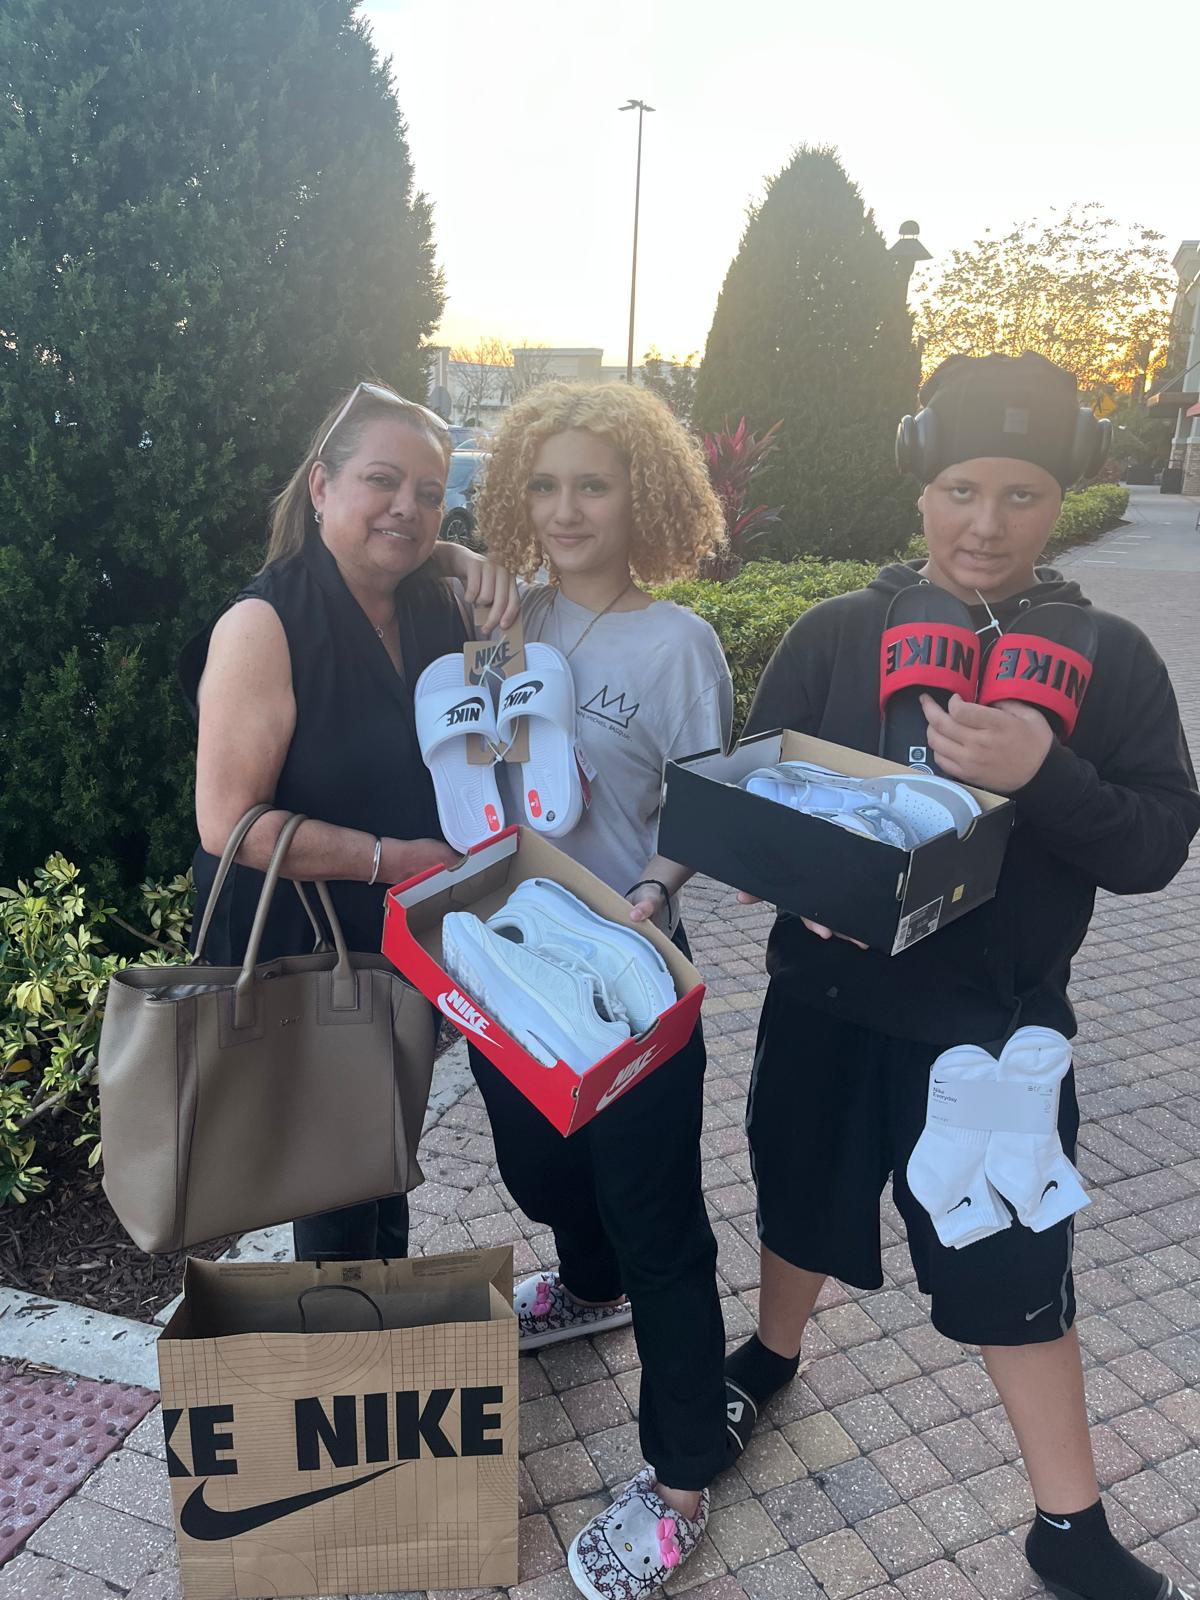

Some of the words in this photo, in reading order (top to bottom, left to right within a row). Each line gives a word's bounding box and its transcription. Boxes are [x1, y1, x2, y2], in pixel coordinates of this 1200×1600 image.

[475, 641, 510, 670] NIKE
[886, 634, 974, 681] NIKE
[996, 647, 1087, 709] NIKE
[446, 707, 480, 727] NIKE
[447, 989, 490, 1035] NIKE
[608, 1044, 656, 1092] NIKE
[932, 1092, 958, 1103] Everyday
[295, 1385, 503, 1471] NIKE
